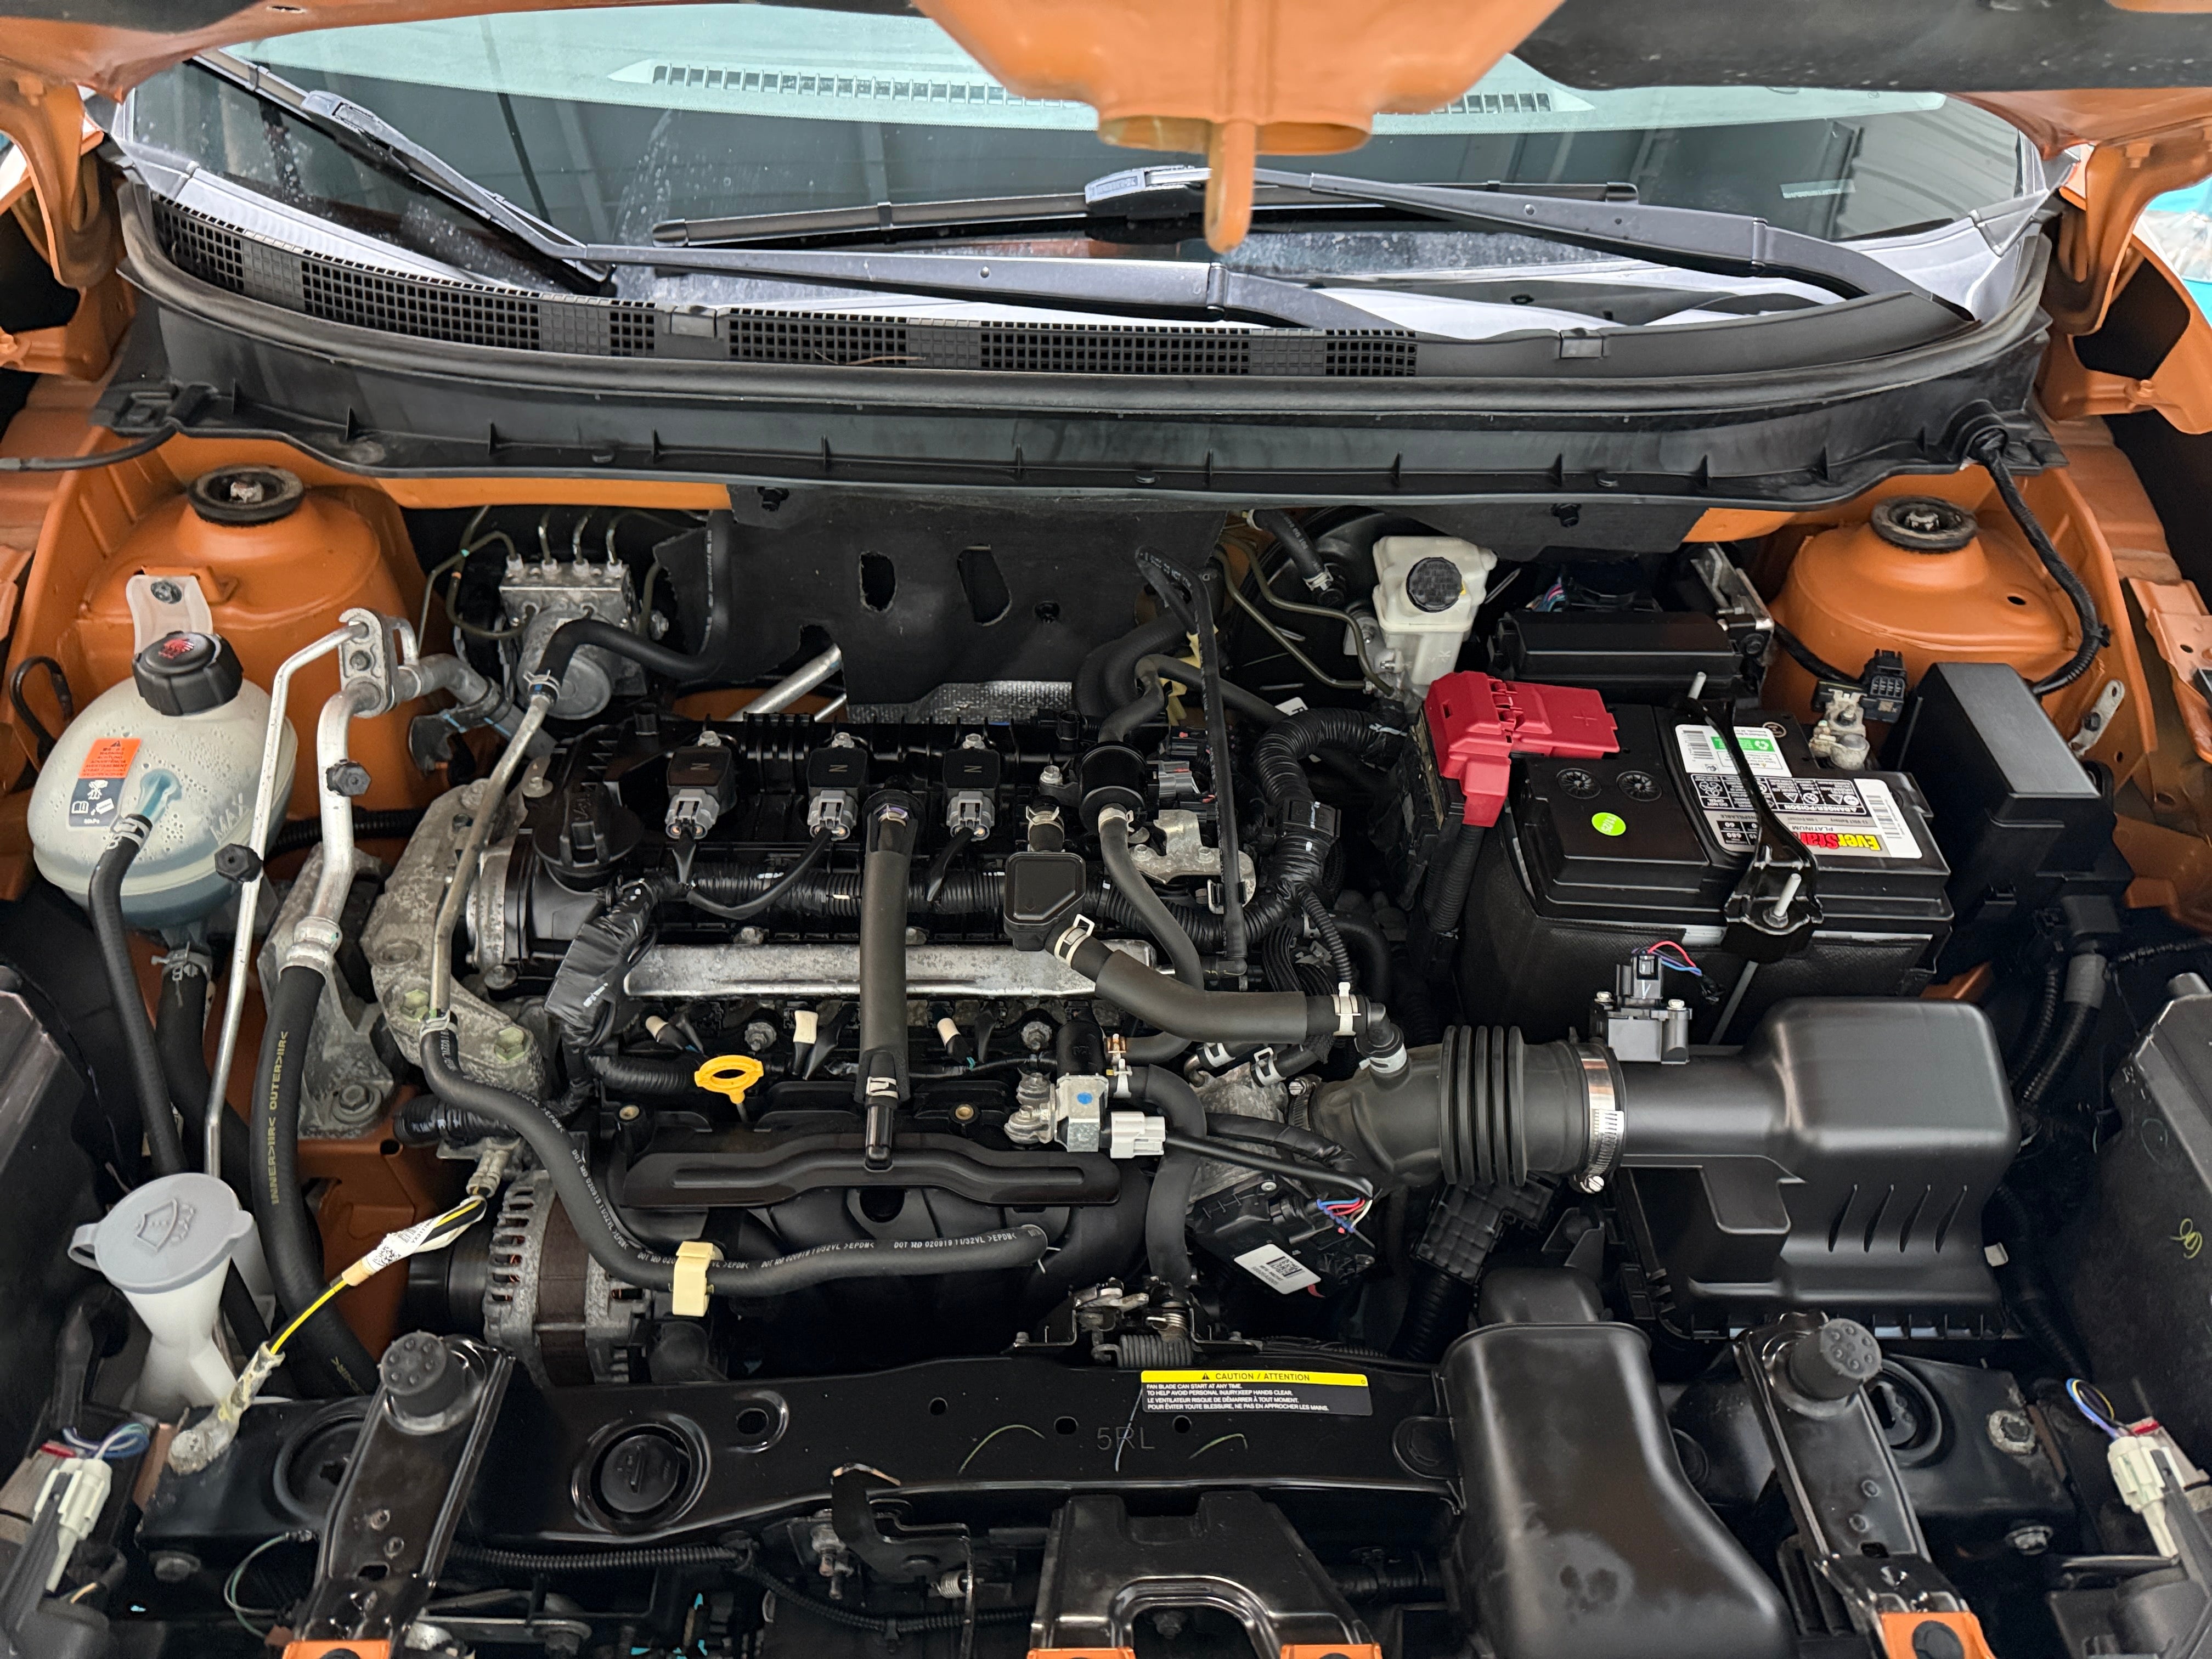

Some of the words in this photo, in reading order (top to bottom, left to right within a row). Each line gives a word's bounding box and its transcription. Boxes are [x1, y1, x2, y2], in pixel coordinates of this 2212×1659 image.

[894, 1241, 909, 1249] DOT
[924, 1238, 953, 1248] 020919
[1215, 1372, 1254, 1381] CAUTION
[1264, 1373, 1311, 1381] ATTENTION
[1097, 1427, 1155, 1450] 5RL
